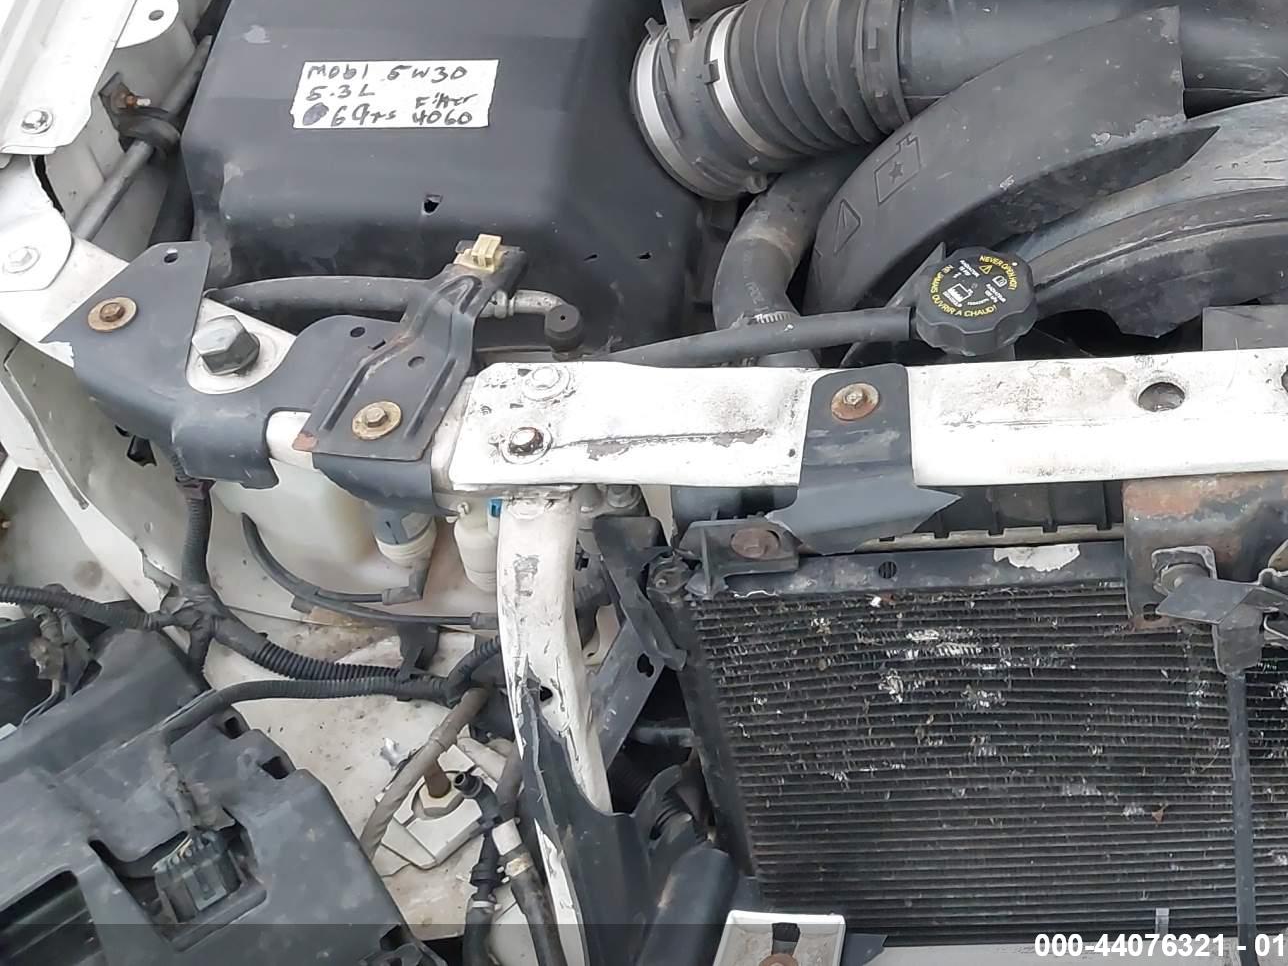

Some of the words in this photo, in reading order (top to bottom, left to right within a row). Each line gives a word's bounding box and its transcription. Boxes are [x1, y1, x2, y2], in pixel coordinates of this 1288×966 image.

[412, 109, 473, 126] 4060
[980, 256, 1004, 266] NEVER
[932, 295, 957, 315] OUVRIR
